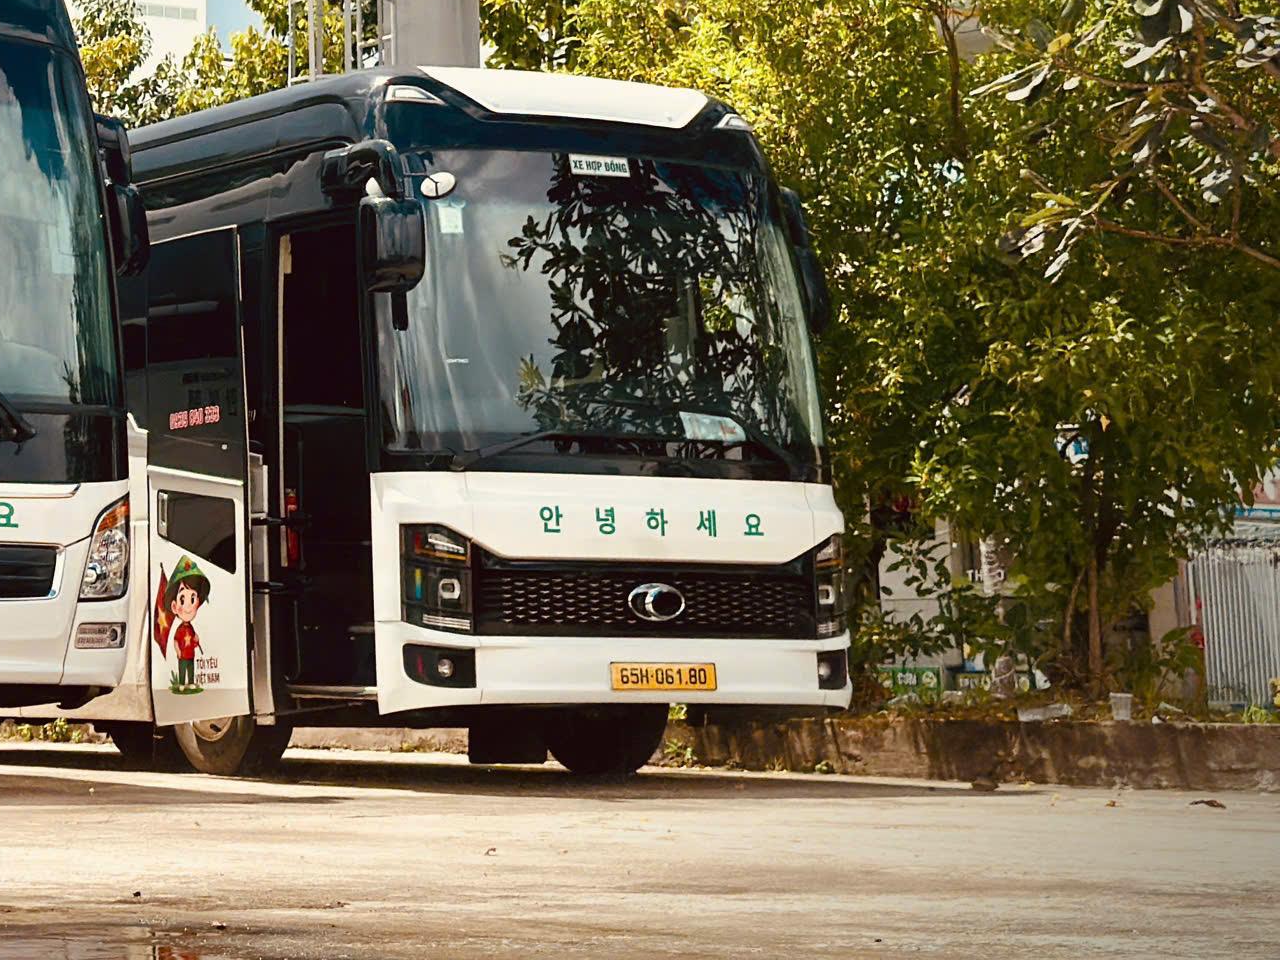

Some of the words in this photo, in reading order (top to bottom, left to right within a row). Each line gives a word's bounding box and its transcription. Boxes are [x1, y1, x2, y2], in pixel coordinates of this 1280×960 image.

[573, 160, 584, 170] XE
[539, 505, 765, 538] 안녕하세요
[620, 667, 707, 685] 65H-061.80
